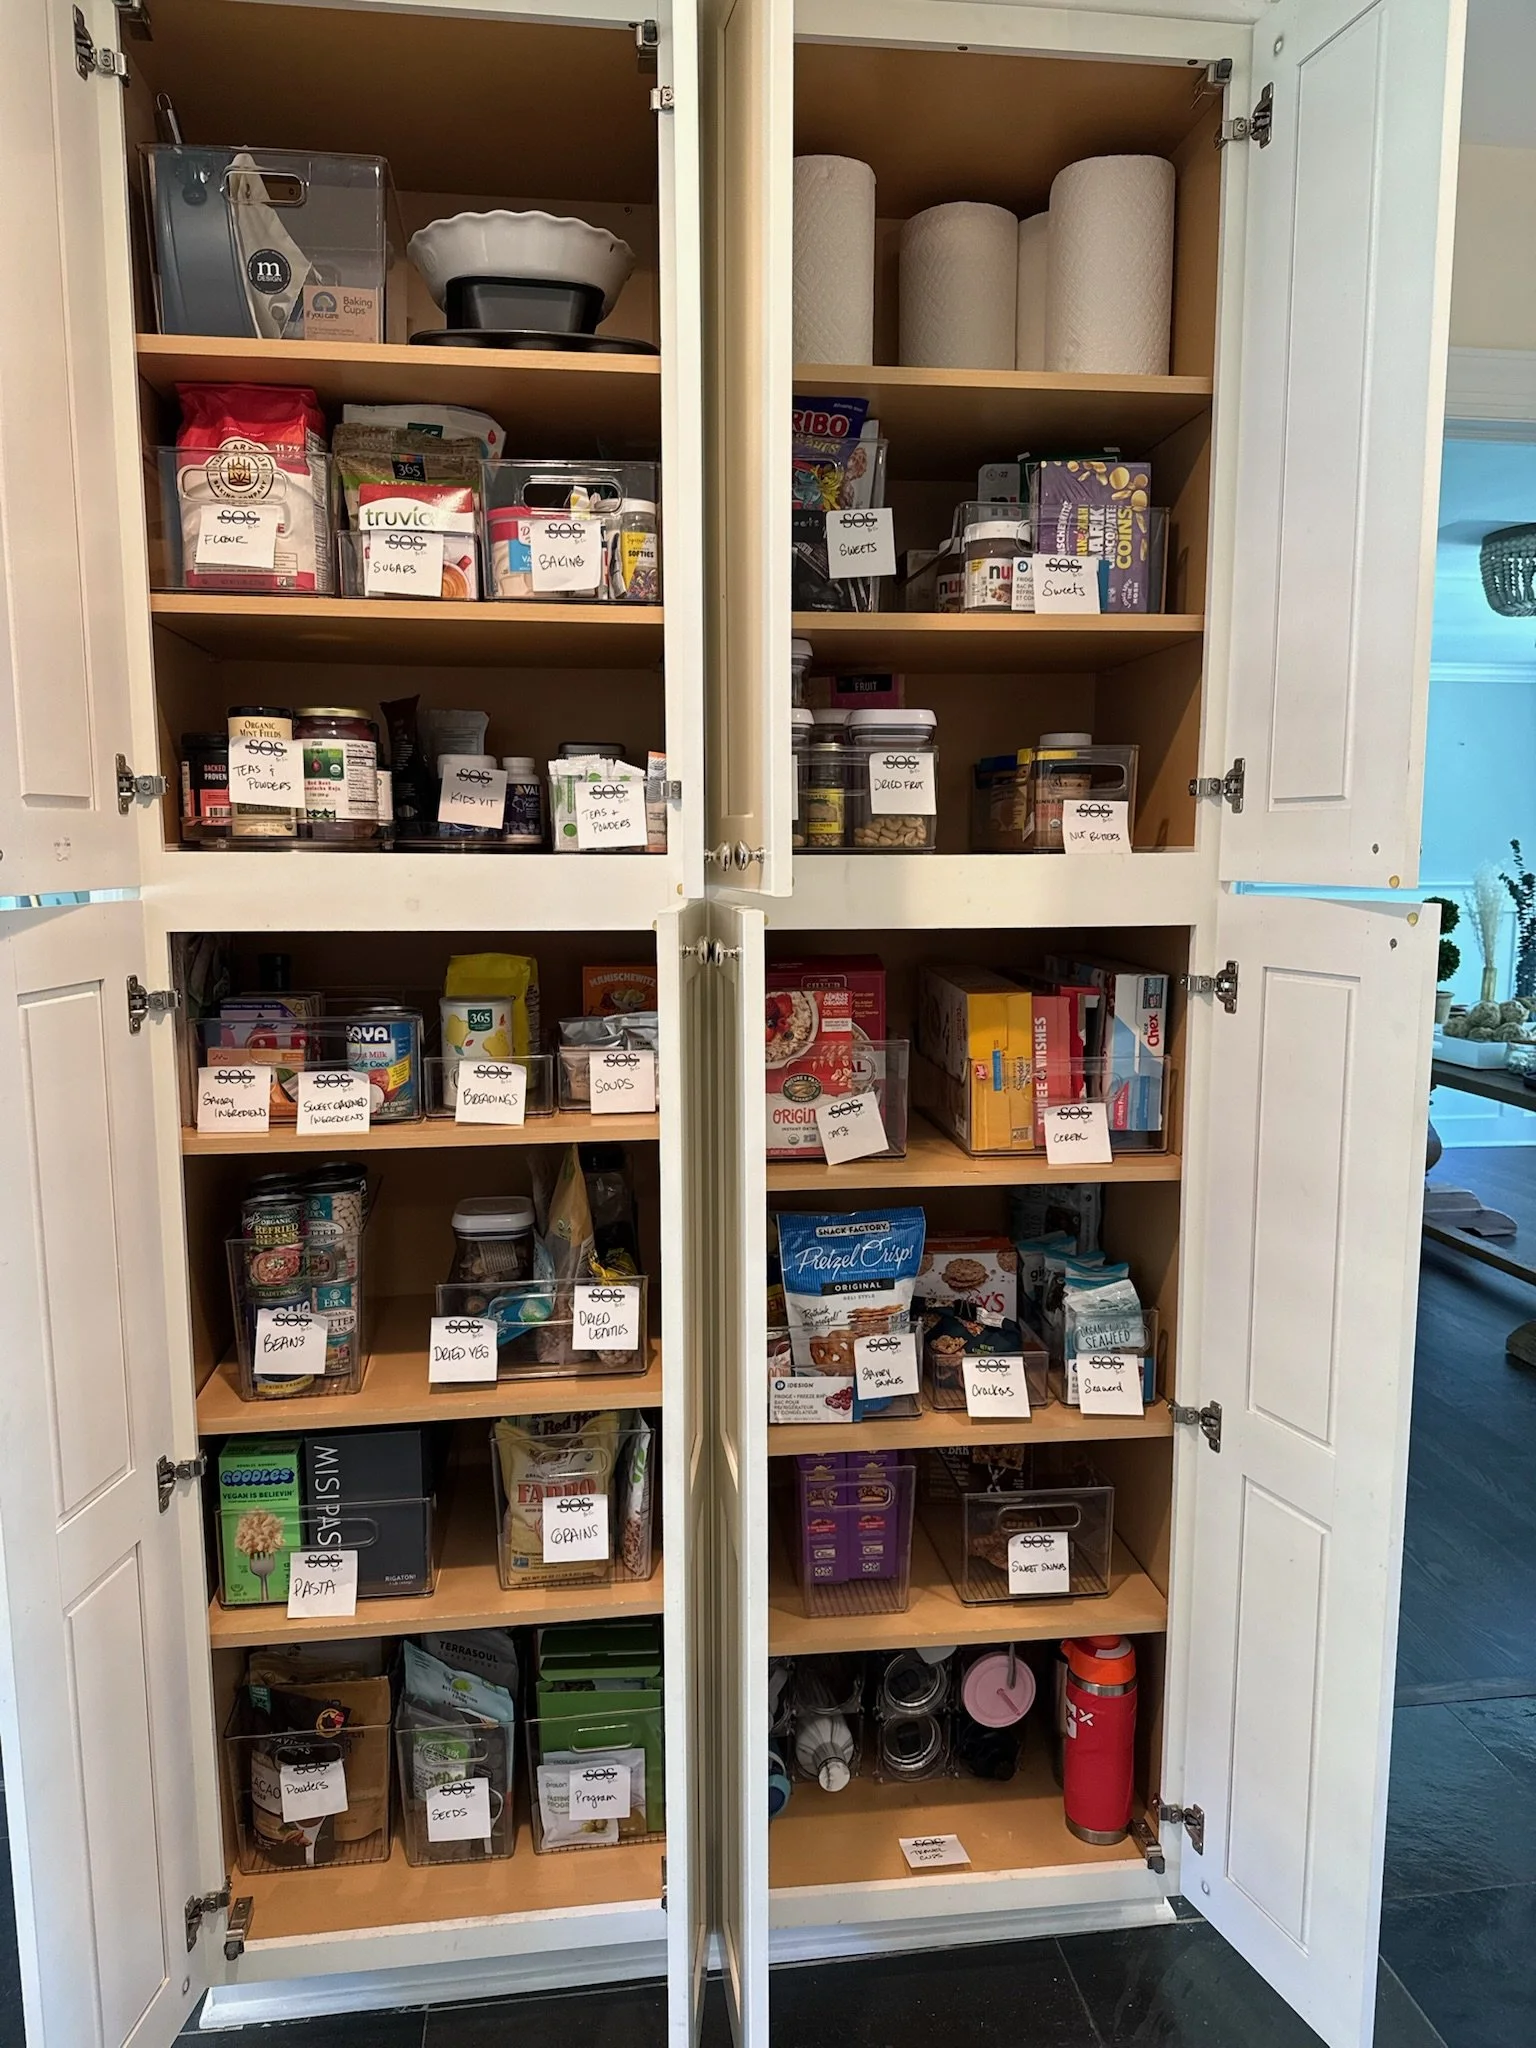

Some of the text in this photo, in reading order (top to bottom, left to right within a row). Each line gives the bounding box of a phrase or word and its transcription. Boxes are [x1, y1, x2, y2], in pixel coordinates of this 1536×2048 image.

[257, 275, 282, 283] DESIGN
[343, 296, 372, 308] Baking
[343, 306, 366, 315] Cups
[397, 463, 421, 478] 365
[1116, 506, 1133, 570] COINS
[839, 543, 877, 556] SWEETS
[373, 561, 417, 574] SUGARS
[538, 553, 585, 571] BAKING
[1042, 580, 1086, 597] Sweets
[854, 681, 878, 691] FRUIT
[244, 720, 276, 730] ORGANIC
[240, 729, 259, 738] MINT
[204, 773, 228, 781] PROVEN
[233, 764, 261, 777] TEAS
[247, 777, 292, 791] POWDERS
[450, 791, 476, 804] KIDS
[582, 808, 608, 821] TEAS
[592, 818, 632, 834] POWDERS
[1069, 830, 1086, 841] NUT
[469, 1013, 491, 1024] 365
[1147, 1014, 1160, 1047] Chex
[1034, 1016, 1048, 1068] WISHES
[370, 1060, 390, 1068] Coco
[595, 1078, 635, 1094] SOUPS
[1116, 1104, 1124, 1126] Gluten
[260, 1217, 293, 1225] ORGANIC
[254, 1223, 299, 1235] REFRIED
[818, 1223, 888, 1236] SNACK FACTORY
[795, 1236, 914, 1280] Pretzel Crisps
[834, 1281, 882, 1292] ORIGINAL
[324, 1299, 346, 1308] EDEN
[579, 1310, 611, 1326] DRIED
[263, 1333, 306, 1353] BEANS
[1085, 1330, 1131, 1350] SEAWEED
[470, 1345, 490, 1360] VEG
[223, 1491, 248, 1500] VEGAN
[249, 1491, 258, 1499] IS
[550, 1524, 599, 1545] GRAINS
[294, 1578, 336, 1598] PASTA
[439, 1641, 499, 1663] TERRASOUL
[285, 1781, 329, 1795] Powders
[575, 1790, 617, 1808] Program
